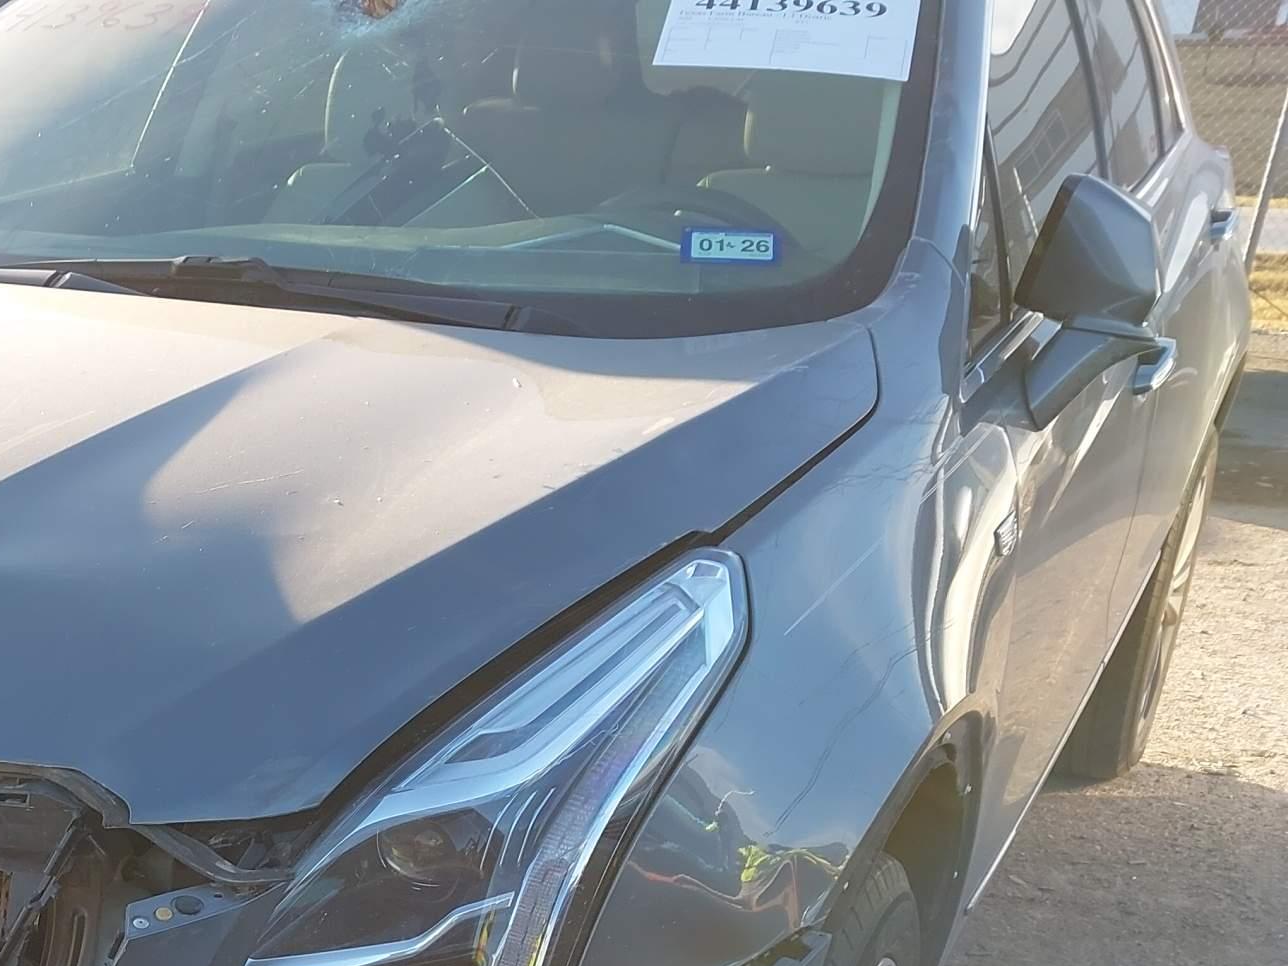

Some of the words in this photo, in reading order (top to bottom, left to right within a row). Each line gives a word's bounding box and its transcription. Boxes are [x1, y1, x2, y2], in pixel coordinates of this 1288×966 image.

[695, 0, 888, 18] 44139639
[699, 238, 725, 252] 01
[740, 239, 770, 253] 26
